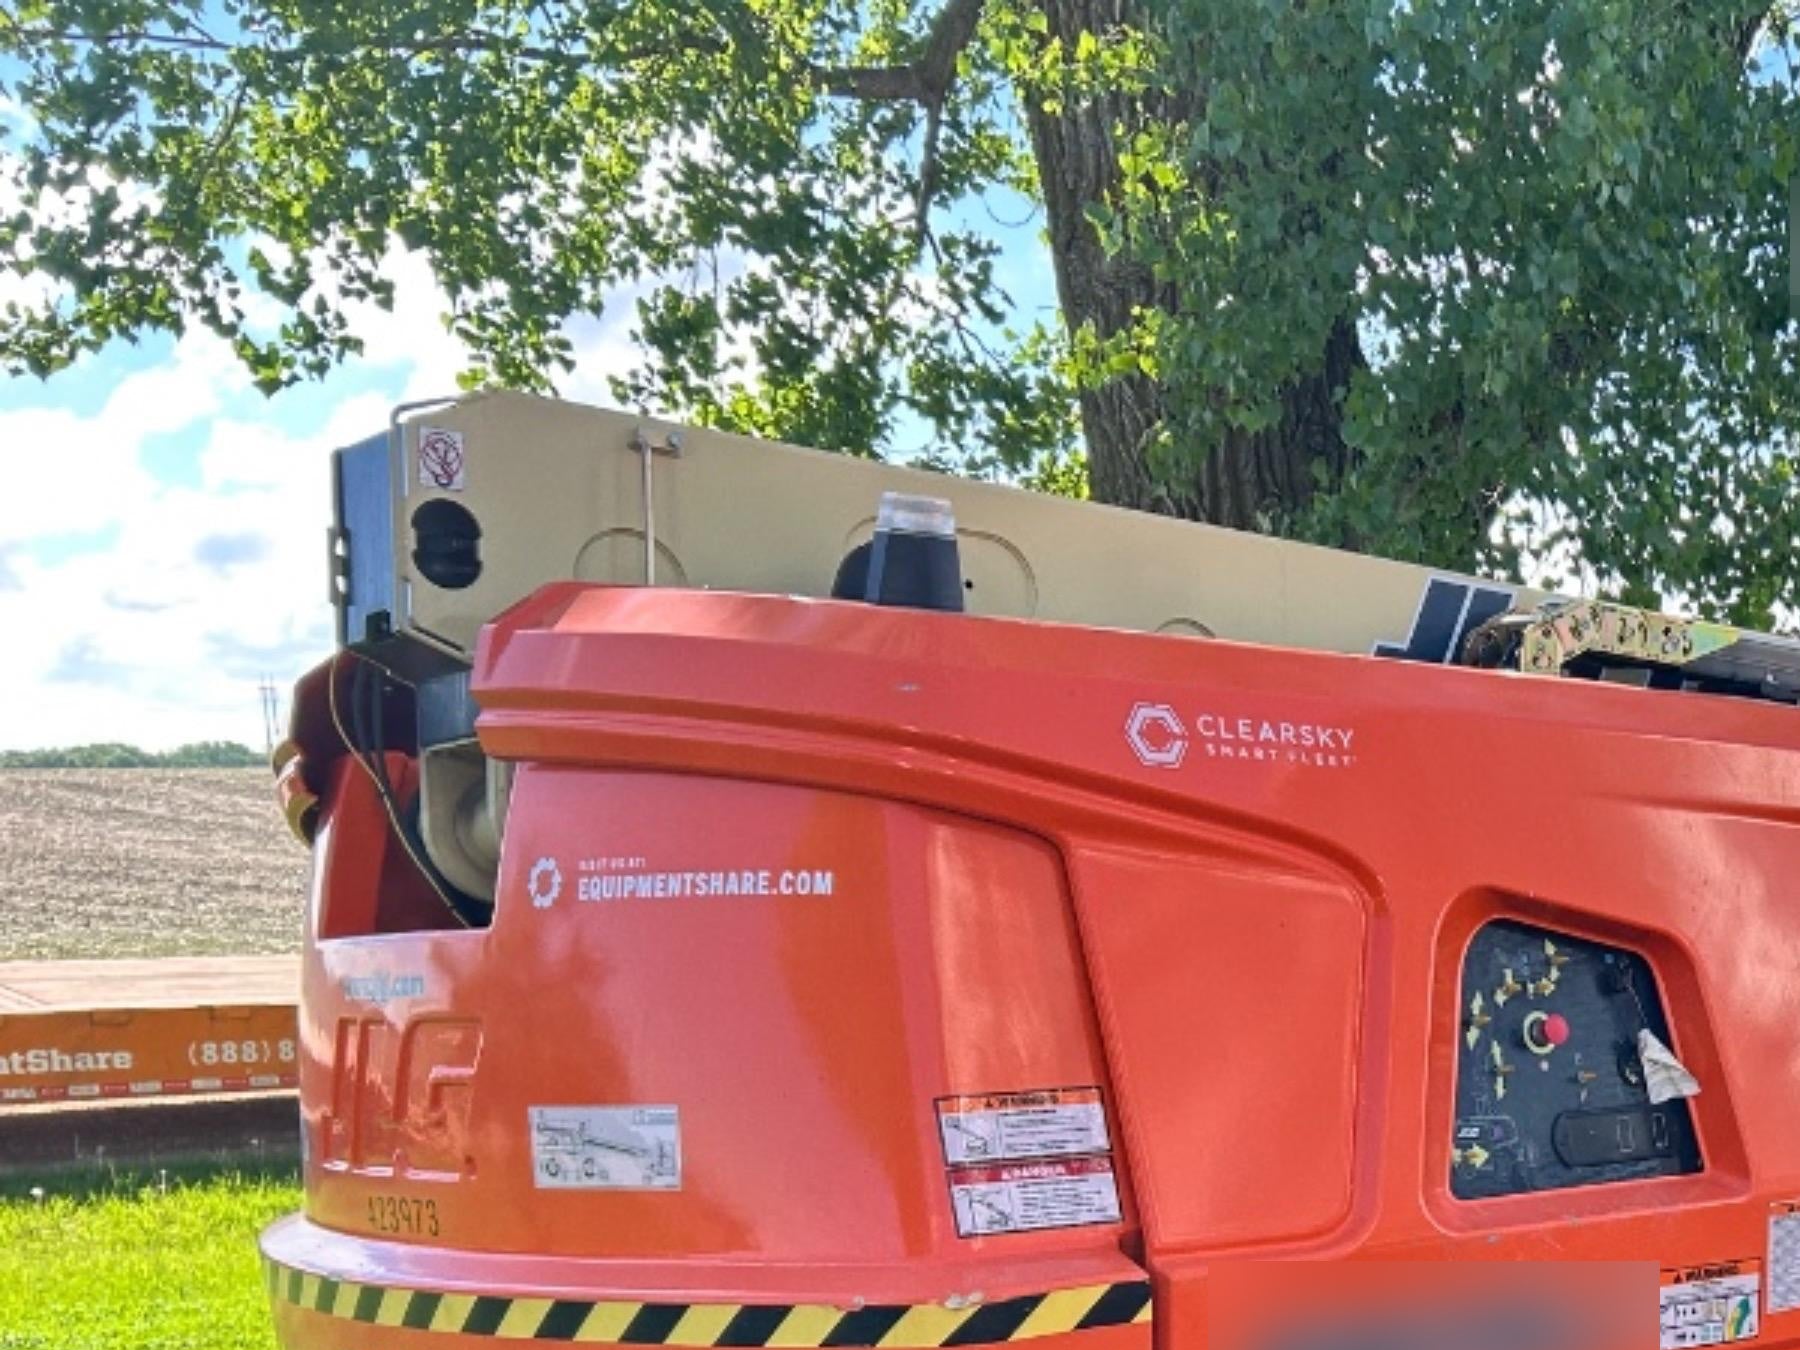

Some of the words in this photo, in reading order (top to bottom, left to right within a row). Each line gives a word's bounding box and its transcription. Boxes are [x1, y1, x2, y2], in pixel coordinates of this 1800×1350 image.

[1196, 715, 1354, 749] CLEARSKY
[577, 870, 834, 902] EQUIPMENTSHARE.COM
[187, 1039, 271, 1066] (888)
[367, 1195, 440, 1237] 423973
